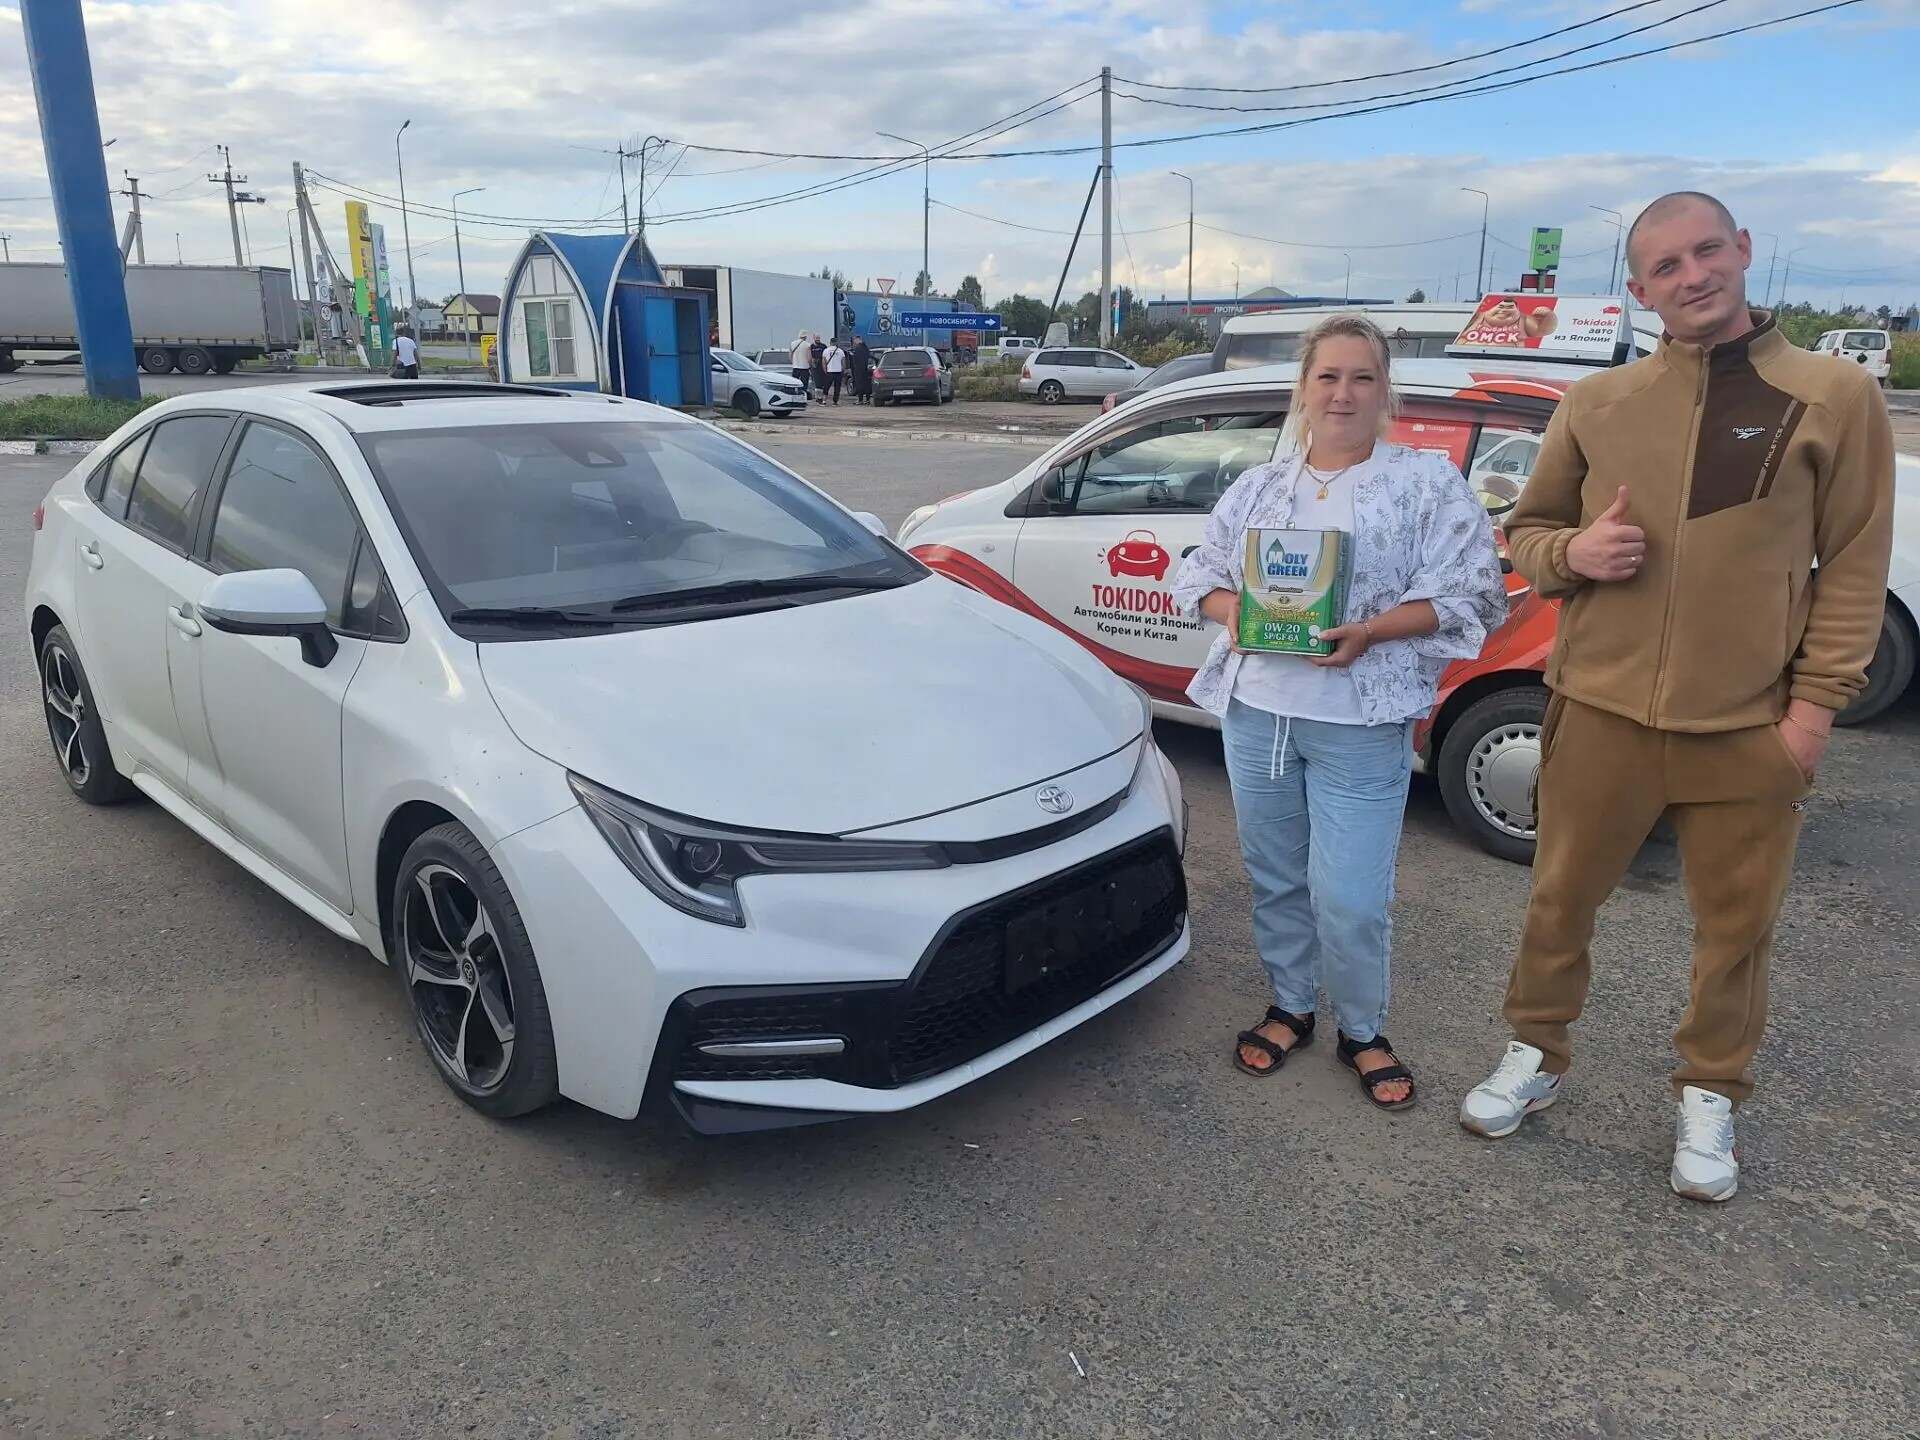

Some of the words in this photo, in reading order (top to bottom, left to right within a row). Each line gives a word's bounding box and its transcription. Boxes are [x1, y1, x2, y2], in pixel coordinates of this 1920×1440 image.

[1572, 318, 1616, 327] Tokidoki
[1466, 331, 1519, 344] ОМСК
[1588, 327, 1613, 335] авто
[1569, 335, 1611, 343] Японии
[1267, 550, 1309, 565] MOLY
[1267, 564, 1308, 577] GREEN
[1073, 605, 1142, 623] Автомобили
[1144, 616, 1158, 626] из
[1097, 621, 1131, 636] Кореи
[1134, 629, 1141, 637] и
[1143, 628, 1178, 642] Китая
